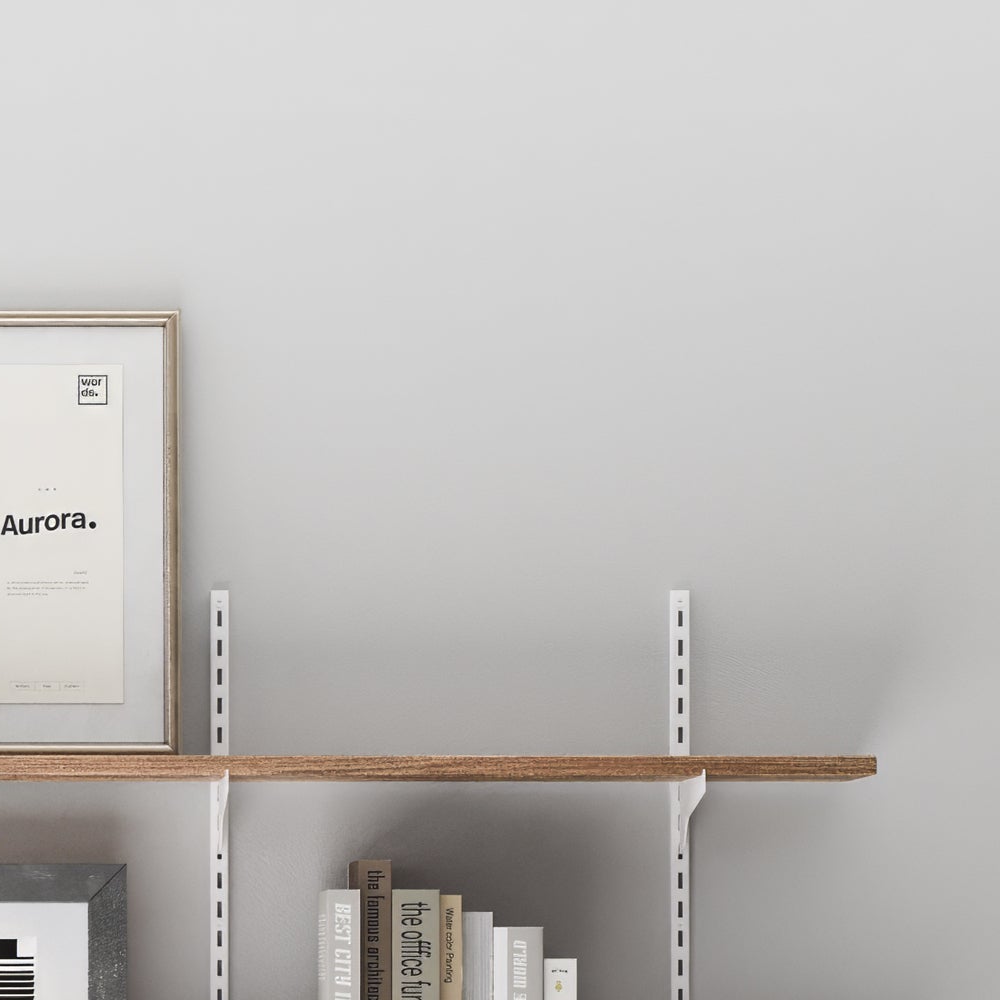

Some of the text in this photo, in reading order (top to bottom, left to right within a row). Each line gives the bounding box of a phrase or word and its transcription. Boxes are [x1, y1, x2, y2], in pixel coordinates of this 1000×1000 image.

[81, 378, 102, 387] wor
[1, 511, 97, 536] Aurora.
[367, 870, 386, 891] the
[367, 896, 386, 942] famous
[401, 901, 428, 926] the
